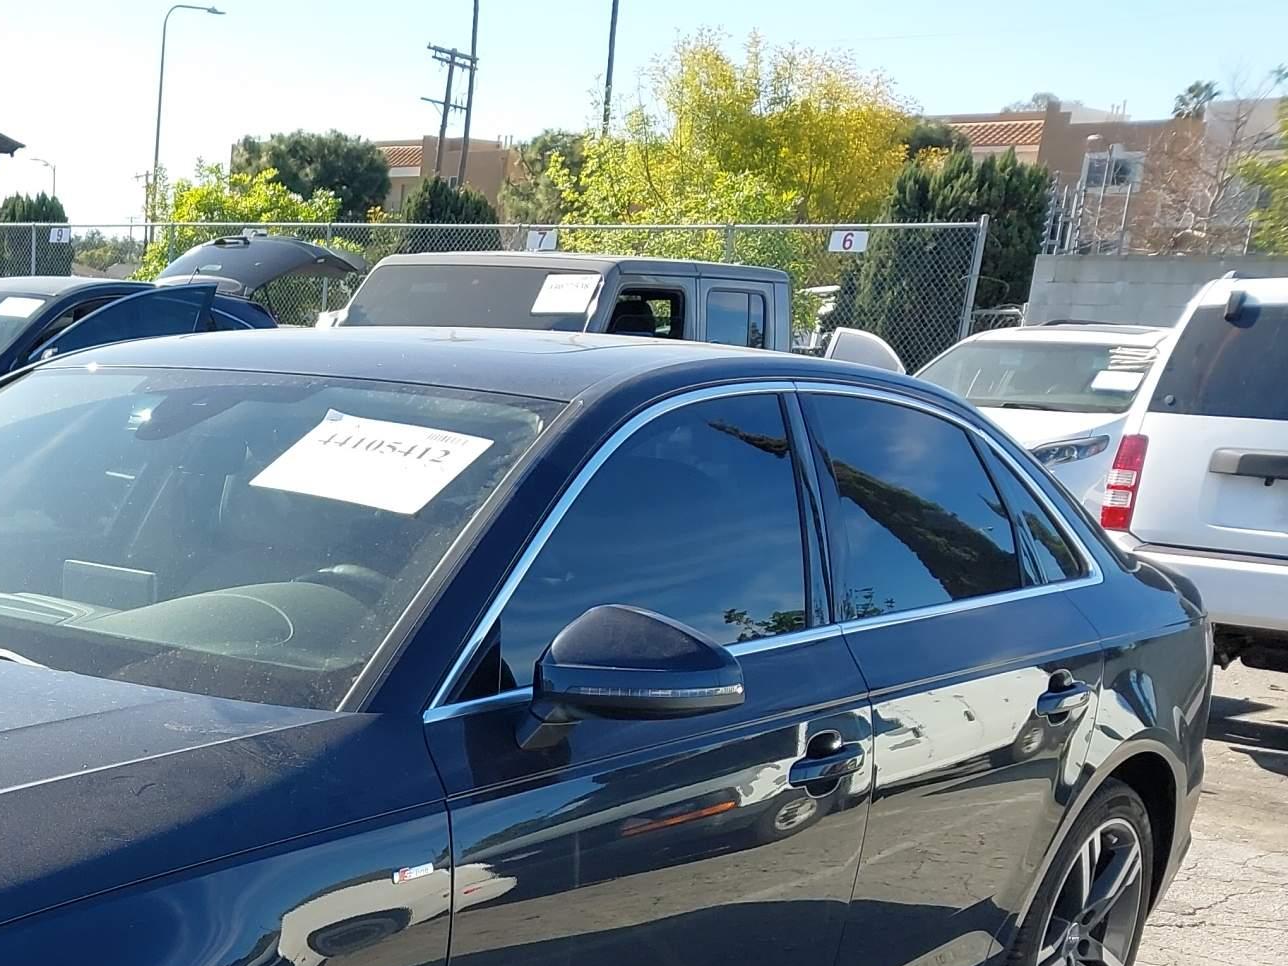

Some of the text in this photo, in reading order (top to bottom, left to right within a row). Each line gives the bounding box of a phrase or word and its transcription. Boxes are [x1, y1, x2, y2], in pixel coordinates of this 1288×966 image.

[56, 229, 64, 241] 9
[537, 231, 548, 249] 7
[842, 232, 855, 250] 6
[317, 432, 452, 464] 44105412
